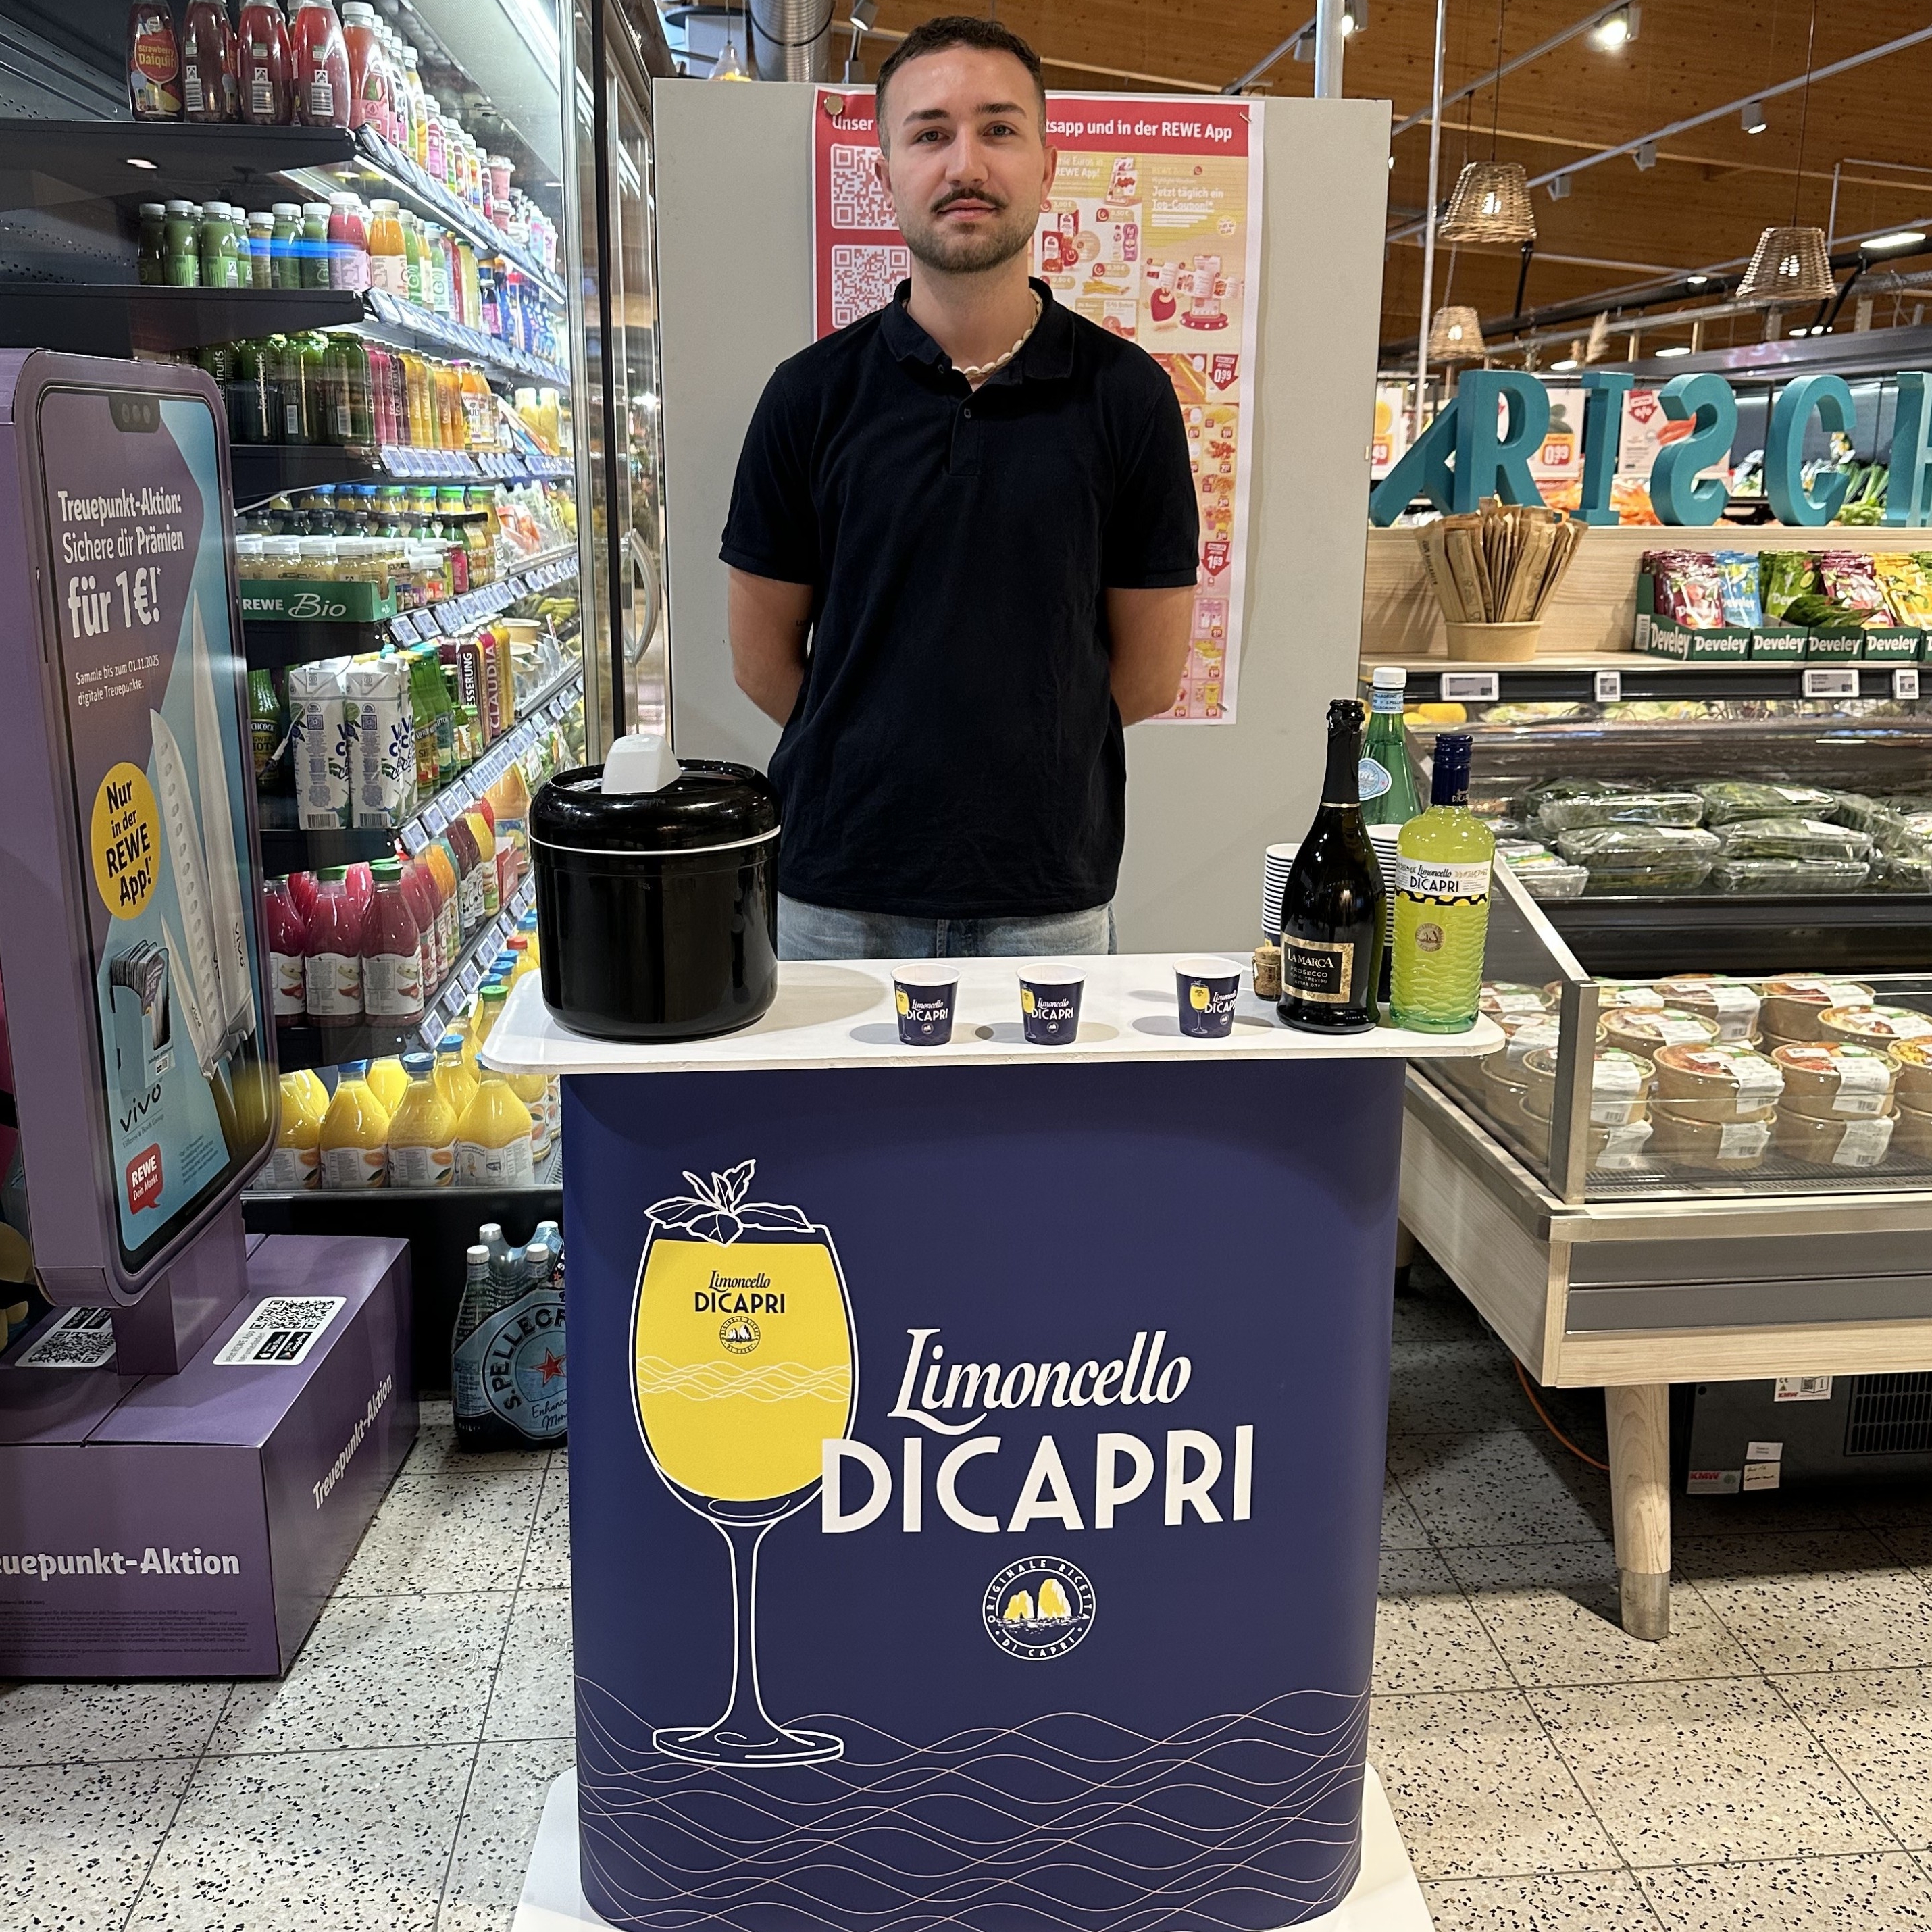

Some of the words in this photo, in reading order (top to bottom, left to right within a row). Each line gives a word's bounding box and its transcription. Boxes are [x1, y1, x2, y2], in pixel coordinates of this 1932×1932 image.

[832, 115, 874, 130] Unser
[1045, 119, 1084, 137] tsapp
[1087, 120, 1113, 134] und
[1117, 120, 1131, 135] in
[1134, 120, 1158, 136] der
[1162, 122, 1201, 138] REWE
[1204, 123, 1232, 143] App
[1152, 186, 1175, 197] Jetzt
[1177, 187, 1209, 200] täglich
[1210, 188, 1223, 198] ein
[213, 350, 225, 381] fruits
[57, 486, 182, 526] Treuepunkt-Aktion:
[63, 531, 114, 564] Sichere
[118, 529, 134, 557] dir
[136, 524, 184, 554] Prämien
[68, 576, 110, 638] für
[243, 599, 284, 611] REWE
[288, 592, 347, 619] Bio
[1651, 622, 1690, 660] Develey
[1694, 636, 1748, 654] Develey
[1753, 634, 1807, 653] Develey
[1809, 636, 1862, 655] Develey
[1866, 635, 1921, 654] Develey
[76, 667, 103, 685] Sammle
[103, 665, 113, 678] bis
[115, 664, 128, 676] zum
[128, 654, 159, 672] 01.11.2025
[463, 652, 476, 706] ESSERUNG
[78, 690, 103, 707] digitale
[104, 678, 145, 697] Treuepunkte.
[485, 644, 500, 728] CLAUDIA
[251, 723, 275, 732] CHCOCK
[106, 779, 132, 814] Nur
[111, 819, 121, 838] in
[122, 809, 137, 832] der
[105, 822, 151, 878] REWE
[1410, 875, 1459, 893] DICAPRI
[1417, 864, 1452, 878] Limoncello
[1288, 948, 1297, 963] LA
[1297, 955, 1335, 969] MARCA
[1290, 965, 1328, 978] PROSECCO
[906, 1008, 948, 1021] DICAPRI
[911, 998, 944, 1011] Limoncello
[1032, 1007, 1074, 1020] DICAPRI
[1037, 997, 1069, 1009] Limoncello
[120, 1084, 161, 1132] vivo
[131, 1154, 157, 1188] REWE
[133, 1184, 144, 1201] Dein
[144, 1174, 159, 1192] Markt
[708, 1270, 771, 1293] Limoncello
[694, 1292, 785, 1314] DICAPRI
[490, 1308, 566, 1410] S.PELLEGR
[886, 1328, 1192, 1435] Limoncello
[313, 1373, 393, 1510] Treuepunkt-Aktion
[821, 1424, 1254, 1533] DICAPRI
[1690, 1472, 1721, 1480] KMW
[0, 1548, 240, 1581] uepunkt-Aktion
[986, 1560, 1046, 1623] ORIGINALE
[1058, 1563, 1092, 1620] RICETTA
[1002, 1638, 1017, 1652] DI
[1028, 1636, 1075, 1657] CAPRI
